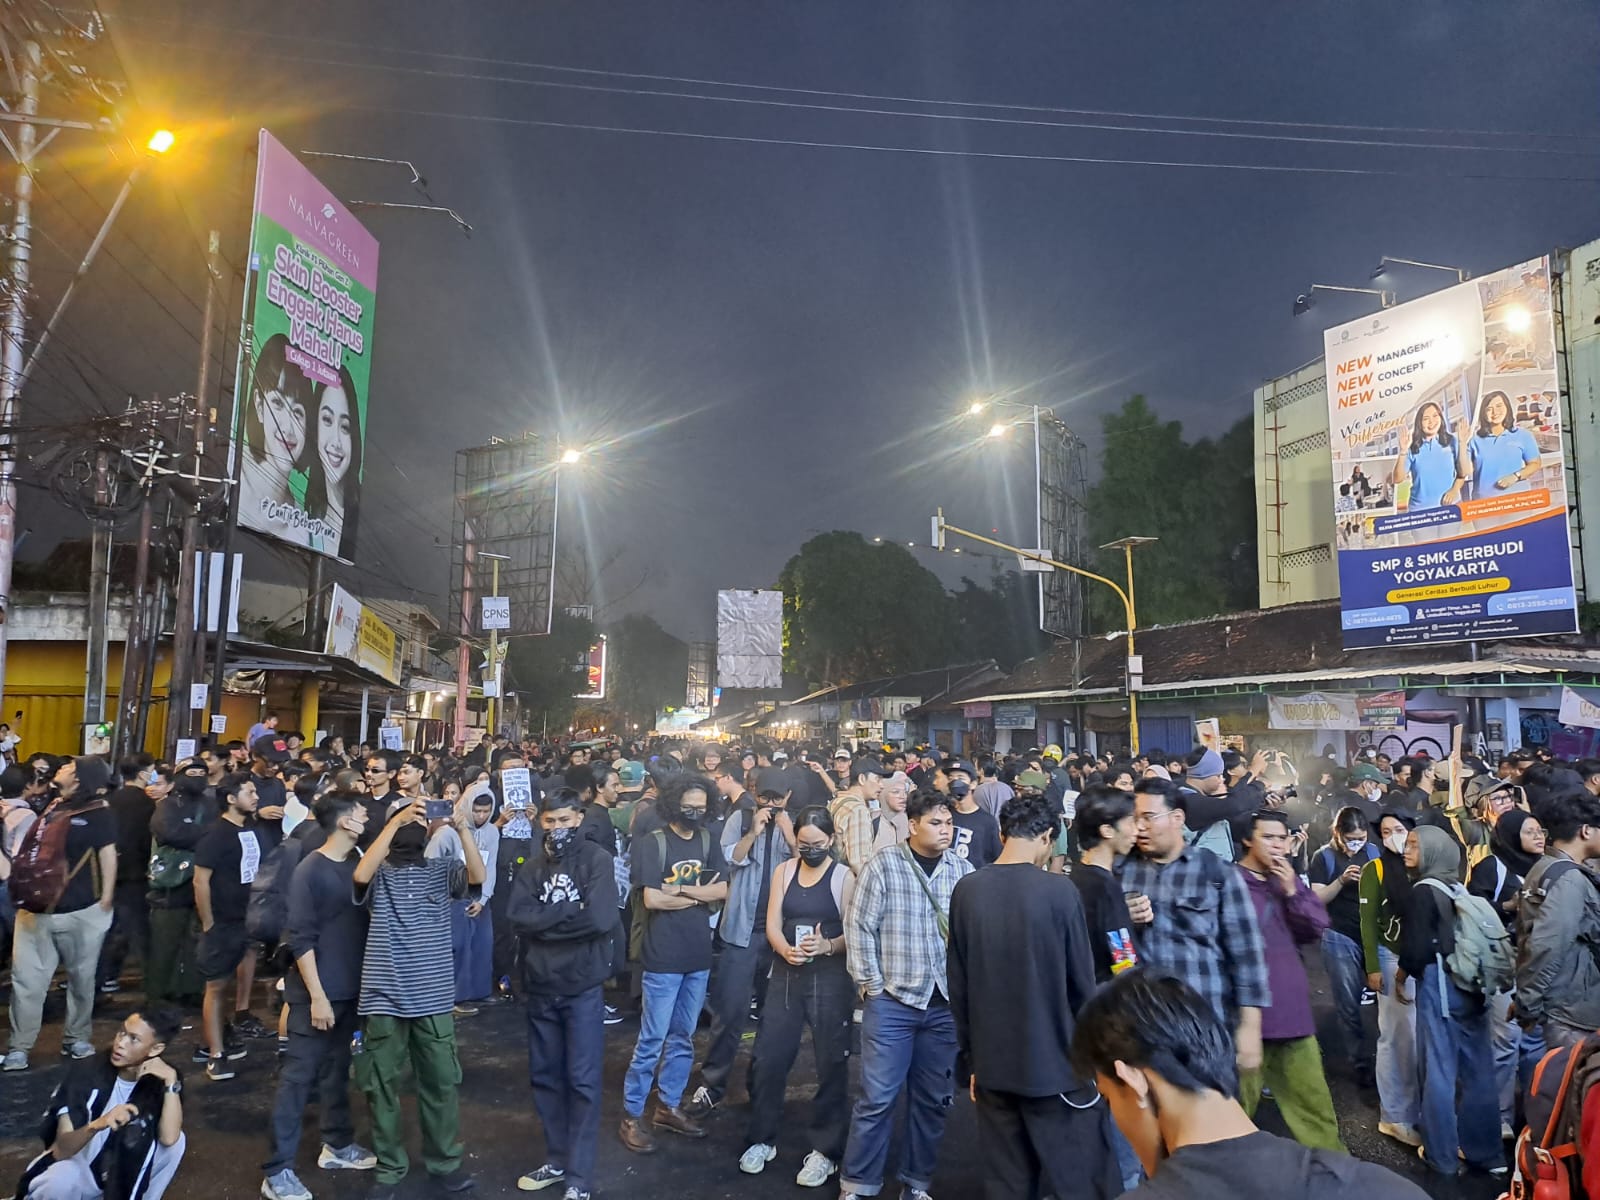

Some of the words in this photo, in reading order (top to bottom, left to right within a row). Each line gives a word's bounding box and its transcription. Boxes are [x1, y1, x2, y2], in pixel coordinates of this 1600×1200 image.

[275, 245, 309, 290] Skin
[311, 269, 361, 323] Booster
[267, 270, 322, 328] Enggak
[325, 307, 362, 353] Harus
[1336, 354, 1372, 376] NEW
[1337, 372, 1373, 393] NEW
[1378, 361, 1425, 381] CONCEPT
[1338, 389, 1374, 409] NEW
[1379, 382, 1413, 399] LOOKS
[1340, 419, 1361, 439] We
[1365, 410, 1386, 424] are
[1346, 414, 1405, 449] Different
[1371, 558, 1401, 573] SMP
[1404, 556, 1414, 568] &
[1417, 551, 1449, 567] SMK
[1453, 540, 1524, 562] BERBUDI
[1394, 560, 1499, 584] YOGYAKARTA
[1396, 591, 1424, 599] Generasi
[1425, 588, 1448, 596] Cerdas
[1450, 584, 1477, 593] Berbudi
[1478, 582, 1499, 590] Luhur
[483, 609, 509, 619] CPNS
